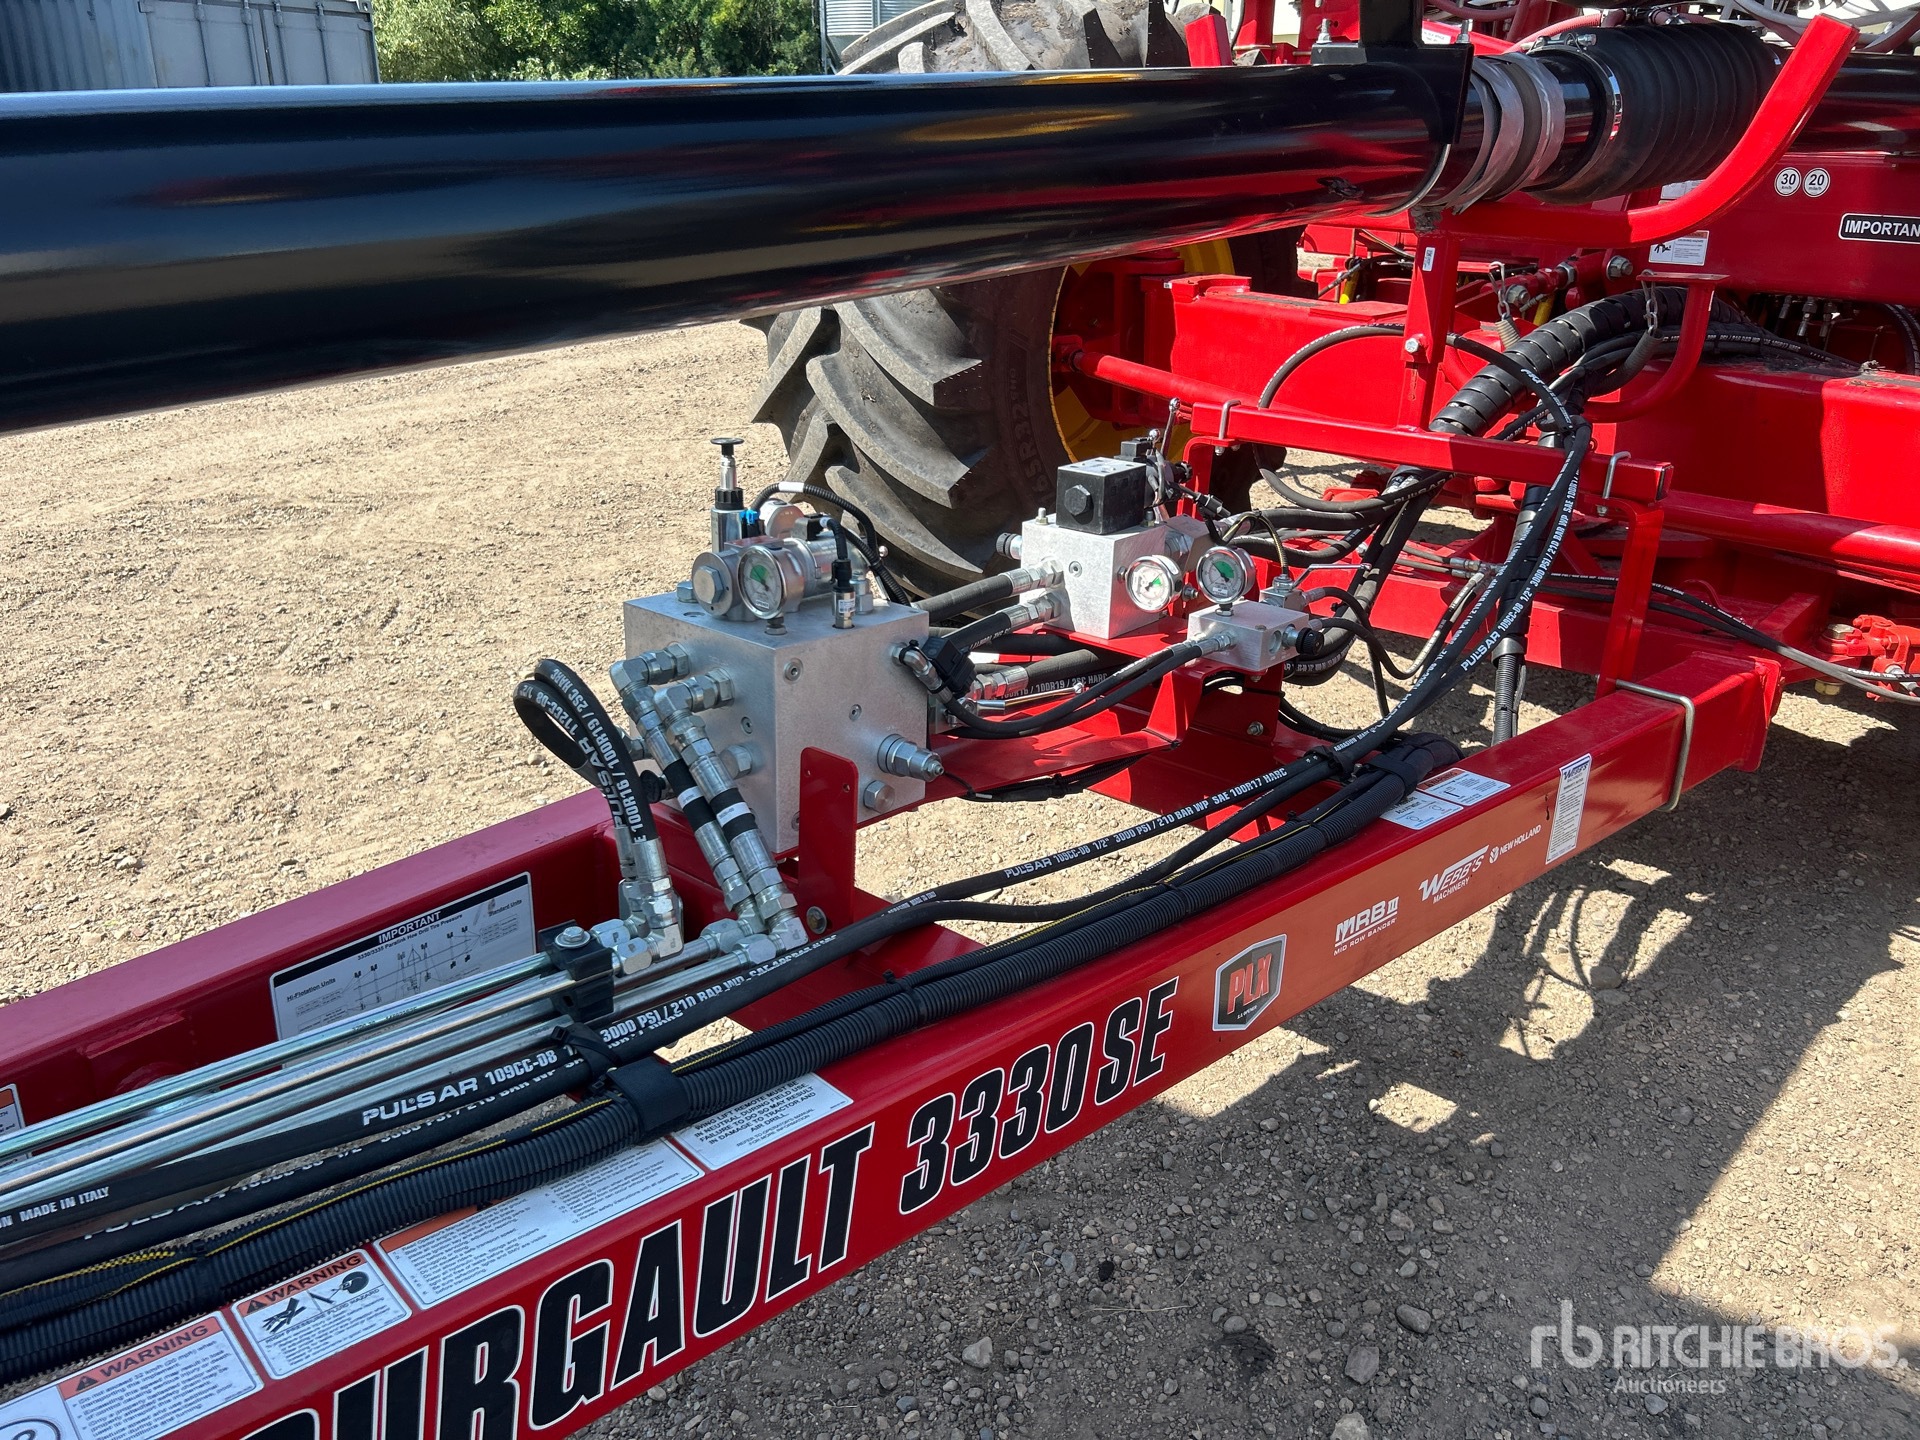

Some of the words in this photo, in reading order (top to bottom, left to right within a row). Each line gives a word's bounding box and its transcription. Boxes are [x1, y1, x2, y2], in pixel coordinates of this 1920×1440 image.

[1781, 173, 1796, 185] 30
[1808, 174, 1825, 186] 20
[1845, 220, 1920, 237] IMPORTAN
[1559, 515, 1568, 526] WP
[1563, 500, 1574, 512] SAE
[1548, 540, 1559, 555] 210
[1553, 527, 1565, 541] BAR
[1530, 569, 1544, 587] 3000
[1540, 553, 1550, 570] PSI
[1461, 631, 1500, 671] PULSAR
[550, 668, 574, 692] HARC
[1036, 679, 1065, 694] 100R19
[536, 691, 578, 735] 112CC-08
[568, 687, 588, 712] 2SC
[588, 719, 620, 769] 100R19
[578, 736, 624, 828] PULSAR
[617, 779, 644, 833] 100R16
[1004, 858, 1052, 878] PULSAR
[1053, 845, 1090, 864] 109CC-08
[1092, 838, 1110, 850] 1/2"
[1113, 828, 1136, 843] 3000
[1136, 824, 1150, 837] PSI
[1157, 814, 1175, 828] 210
[1176, 806, 1194, 821] BAR
[1195, 801, 1209, 813] WP
[1212, 791, 1230, 805] SAE
[1230, 778, 1262, 798] 100R17
[1264, 767, 1287, 783] HARC
[1500, 842, 1513, 855] NEW
[1514, 825, 1541, 847] HOLLAND
[1419, 845, 1489, 901] WEBB'S
[1433, 878, 1469, 904] MACHINERY
[378, 910, 441, 943] IMPORTANT
[384, 936, 406, 949] Paralink
[418, 926, 429, 935] Drill
[440, 913, 462, 926] Pressure
[1334, 945, 1348, 955] MID
[1350, 935, 1366, 947] ROW
[1368, 917, 1397, 938] BANDER
[1336, 899, 1385, 942] MRB
[286, 984, 320, 1001] Hi-Flotation
[320, 977, 335, 987] Units
[1227, 953, 1272, 1015] PLX
[362, 1078, 478, 1126] PULSAR
[485, 1050, 558, 1086] 109CC-08
[600, 1018, 636, 1043] 3000
[638, 1010, 660, 1029] PSI
[695, 1118, 717, 1130] WING
[716, 1110, 734, 1120] LIFT
[733, 1095, 766, 1112] REMOTE
[765, 1085, 787, 1097] MUST
[699, 1124, 733, 1142] FAILURE
[744, 1112, 758, 1120] DO
[769, 1099, 786, 1108] MAY
[785, 1086, 815, 1101] RESULT
[703, 1114, 741, 1133] NEUTRAL
[739, 1100, 770, 1116] DURING
[769, 1090, 792, 1102] FIELD
[790, 1082, 809, 1092] USE.
[899, 1021, 1095, 1215] 3330
[1095, 976, 1179, 1106] SE
[717, 1121, 753, 1140] DAMAGE
[764, 1099, 800, 1117] TRACTOR
[798, 1091, 816, 1101] AND
[748, 1123, 764, 1132] AIR
[763, 1111, 789, 1125] DRILL.
[20, 1202, 58, 1222] MADE
[61, 1196, 75, 1209] IN
[79, 1186, 109, 1205] ITALY
[241, 1122, 874, 1440] RGAULT
[264, 1254, 362, 1303] WARNING
[99, 1323, 209, 1379] WARNING
